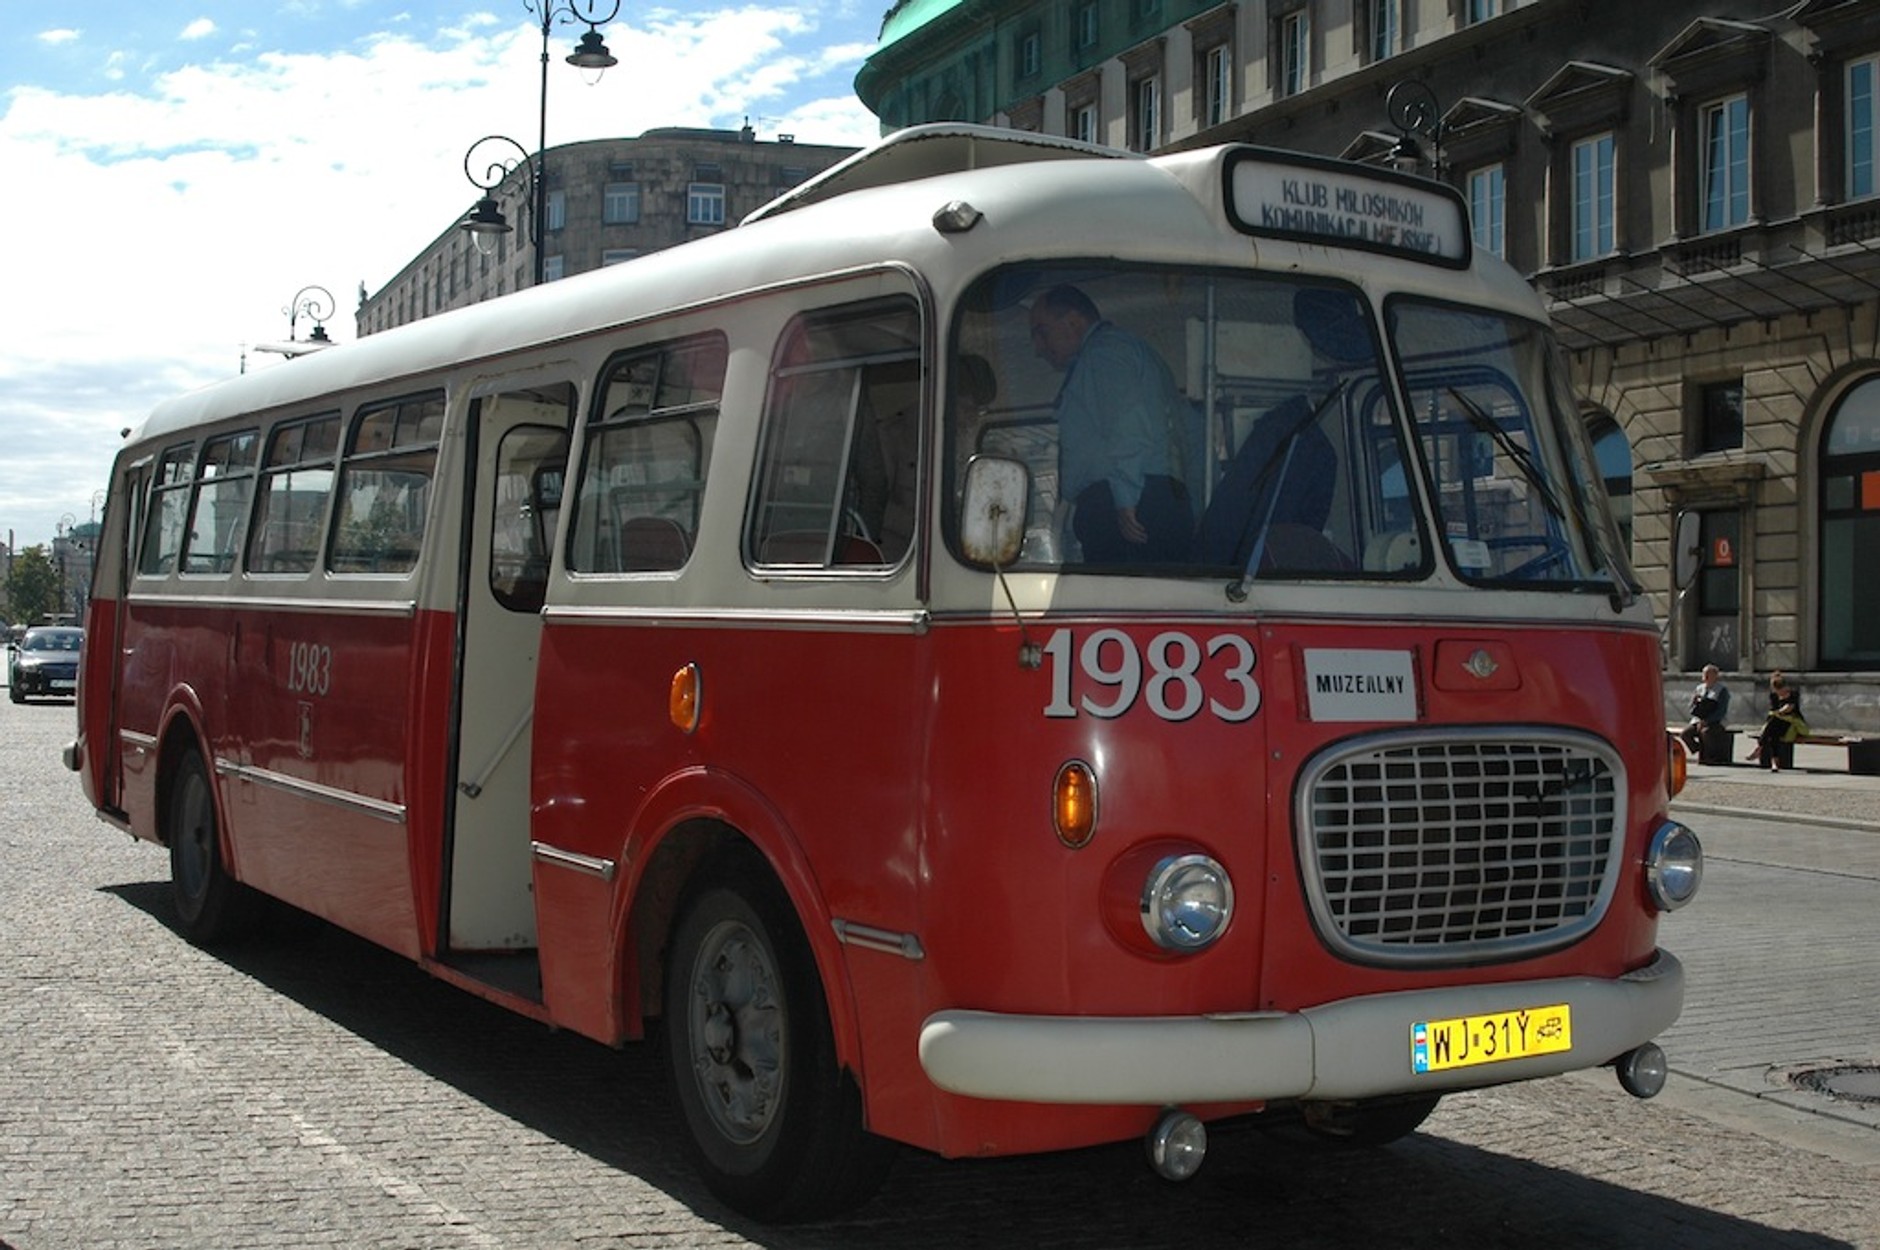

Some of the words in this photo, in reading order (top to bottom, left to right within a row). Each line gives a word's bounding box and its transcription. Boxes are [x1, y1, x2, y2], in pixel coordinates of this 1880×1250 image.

[1282, 179, 1328, 208] KLUB
[288, 642, 331, 696] 1983
[1042, 628, 1262, 723] 1983
[1316, 674, 1404, 694] MUZEALNY
